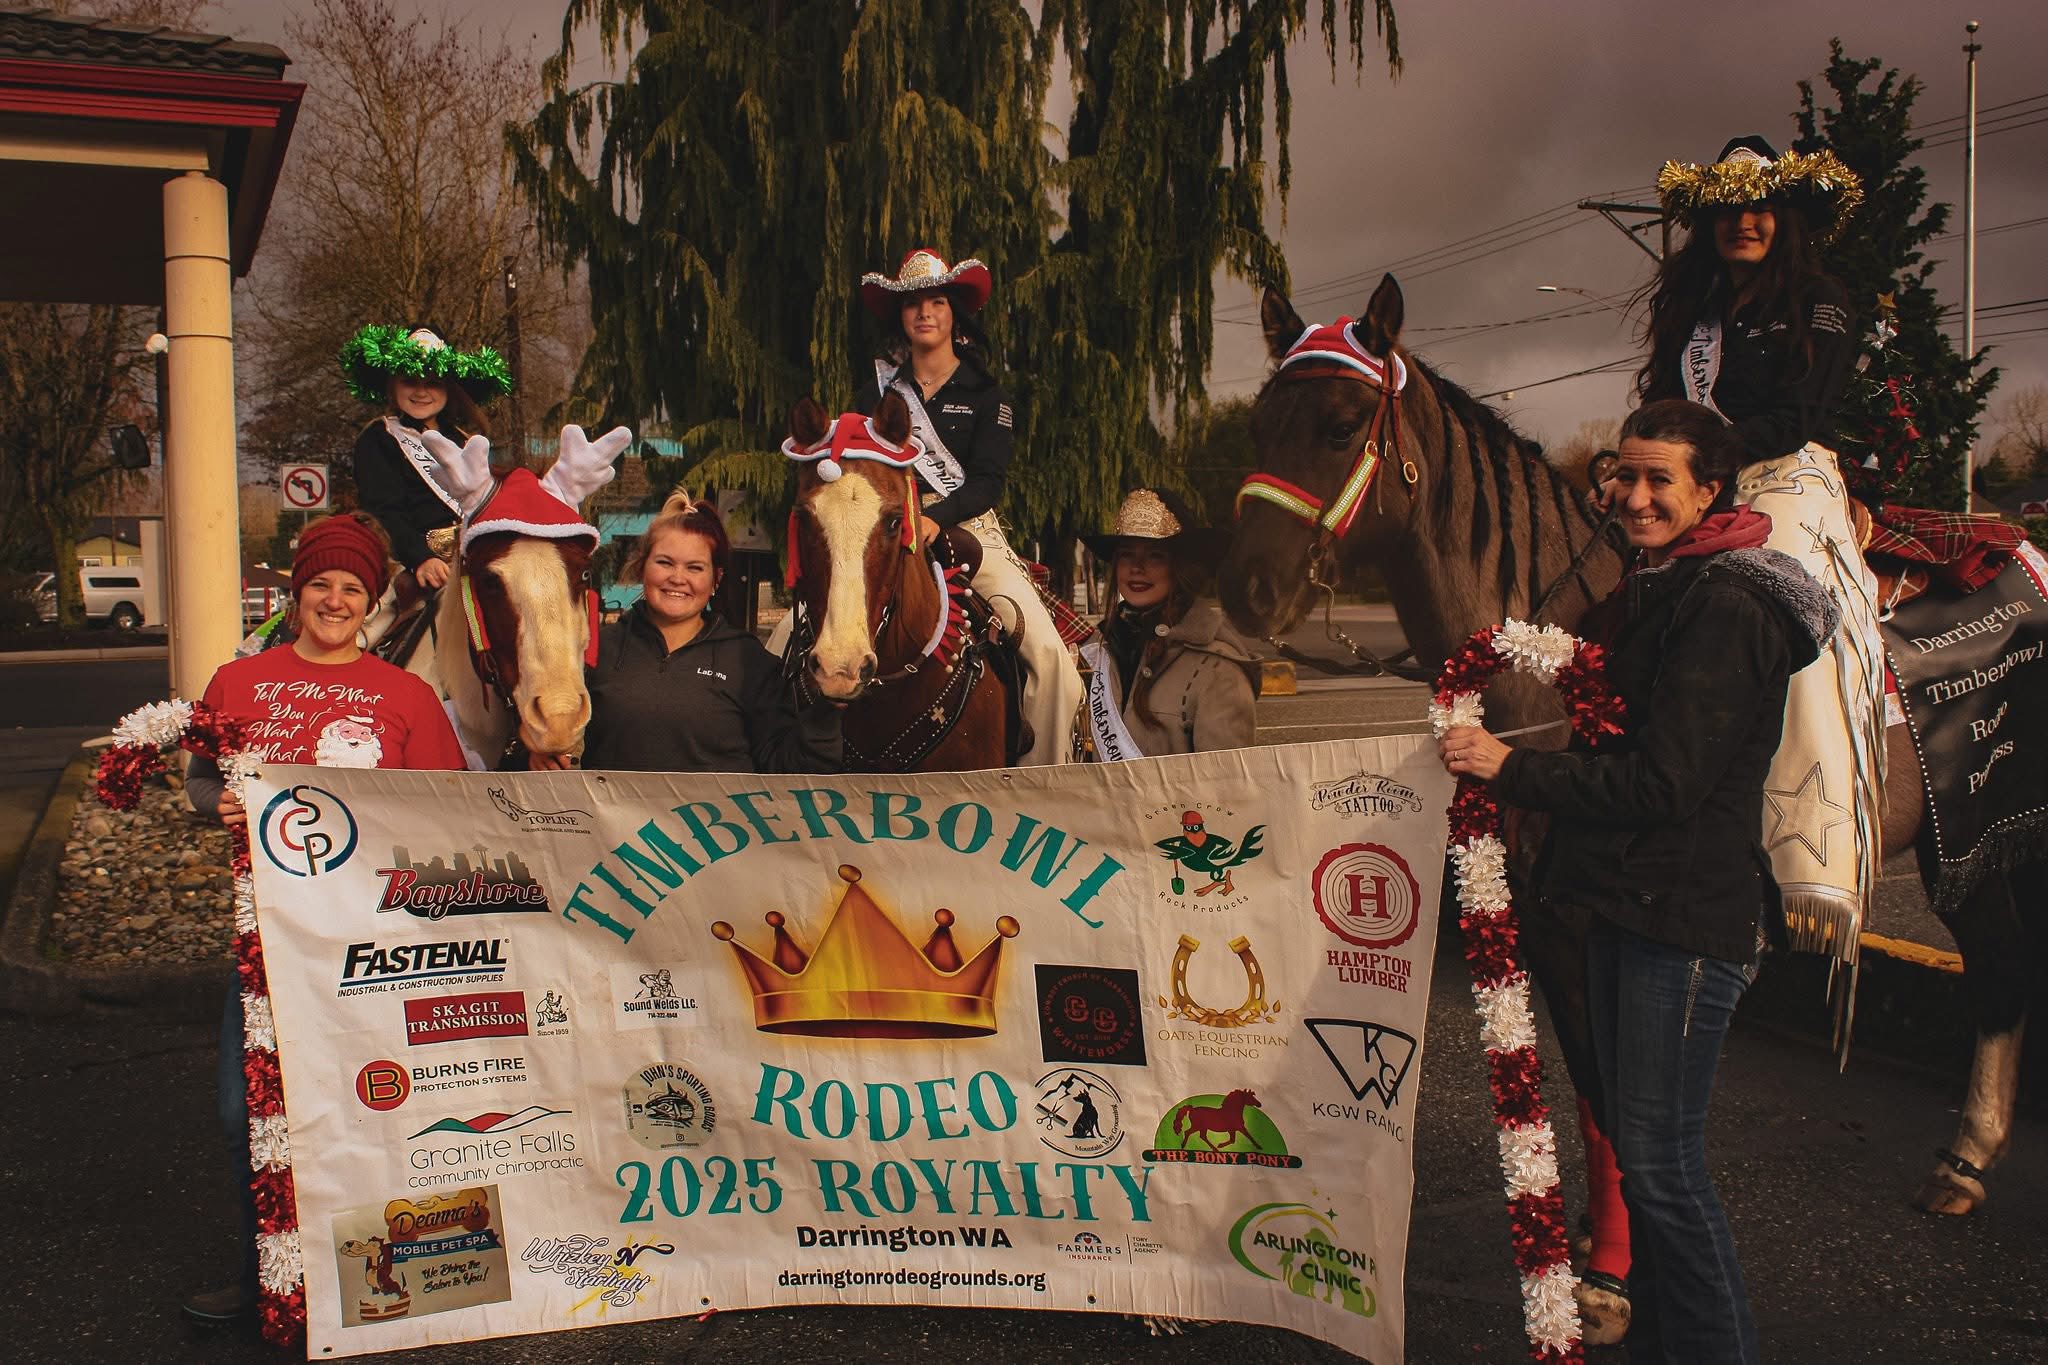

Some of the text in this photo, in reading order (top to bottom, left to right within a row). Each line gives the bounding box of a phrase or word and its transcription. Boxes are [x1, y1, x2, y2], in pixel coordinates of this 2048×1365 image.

[1690, 334, 1713, 404] Timberbo
[1910, 599, 2032, 655] Darrington
[697, 667, 727, 680] LaDna
[254, 681, 384, 705] Tell Me What
[269, 702, 305, 720] You
[1969, 701, 2007, 742] Roo
[248, 722, 304, 739] Want
[252, 743, 307, 762] What
[1968, 740, 2014, 794] Press
[1318, 780, 1414, 802] Powder Room
[1145, 802, 1234, 820] Green Crow
[1342, 795, 1393, 812] TATTOO
[526, 815, 578, 826] TOPLINE
[563, 788, 1126, 945] TIMBERBOWL
[376, 867, 548, 921] Bayshore
[1158, 891, 1249, 913] Rock Products
[1344, 874, 1392, 920] H
[342, 938, 507, 979] FASTENAL
[1327, 950, 1411, 978] HAMPTON
[337, 974, 504, 998] INDUSTRIAL & CONSTRUCTION SUPPLIES
[1337, 967, 1407, 993] LUMBER
[432, 1002, 499, 1018] SKAGIT
[624, 998, 698, 1012] Sound Welds LLC.
[408, 1013, 526, 1034] TRANSMISSION
[537, 1029, 554, 1037] Since
[1158, 1030, 1289, 1047] OATS EQUESTRIAN
[1194, 1044, 1259, 1059] FENCING
[412, 1057, 526, 1080] BURNS FIRE
[365, 1068, 403, 1105] B
[413, 1074, 527, 1093] PROTECTION SYSTEMS
[640, 1064, 716, 1133] JOHN'S SPORTING GOODS
[751, 1061, 1018, 1142] RODEO
[1312, 1102, 1405, 1142] KGW RANC
[410, 1130, 576, 1170] Granite Falls
[1075, 1144, 1103, 1152] Mountain
[1152, 1150, 1291, 1168] THE BONY PONY
[408, 1156, 584, 1189] Community Chiropractic
[616, 1156, 1156, 1224] 2025 ROYALTY
[393, 1199, 481, 1236] Deanna's
[393, 1234, 489, 1256] MOBILE PET SPA
[797, 1224, 1013, 1252] Darrington WA
[1057, 1243, 1121, 1255] FARMERS
[1068, 1254, 1112, 1262] INSURANCE
[1253, 1230, 1366, 1271] ARLINGTON
[565, 1266, 651, 1307] Starlight
[778, 1268, 1046, 1292] darringtonrodeogrounds.org
[1300, 1263, 1361, 1295] CLINIC
